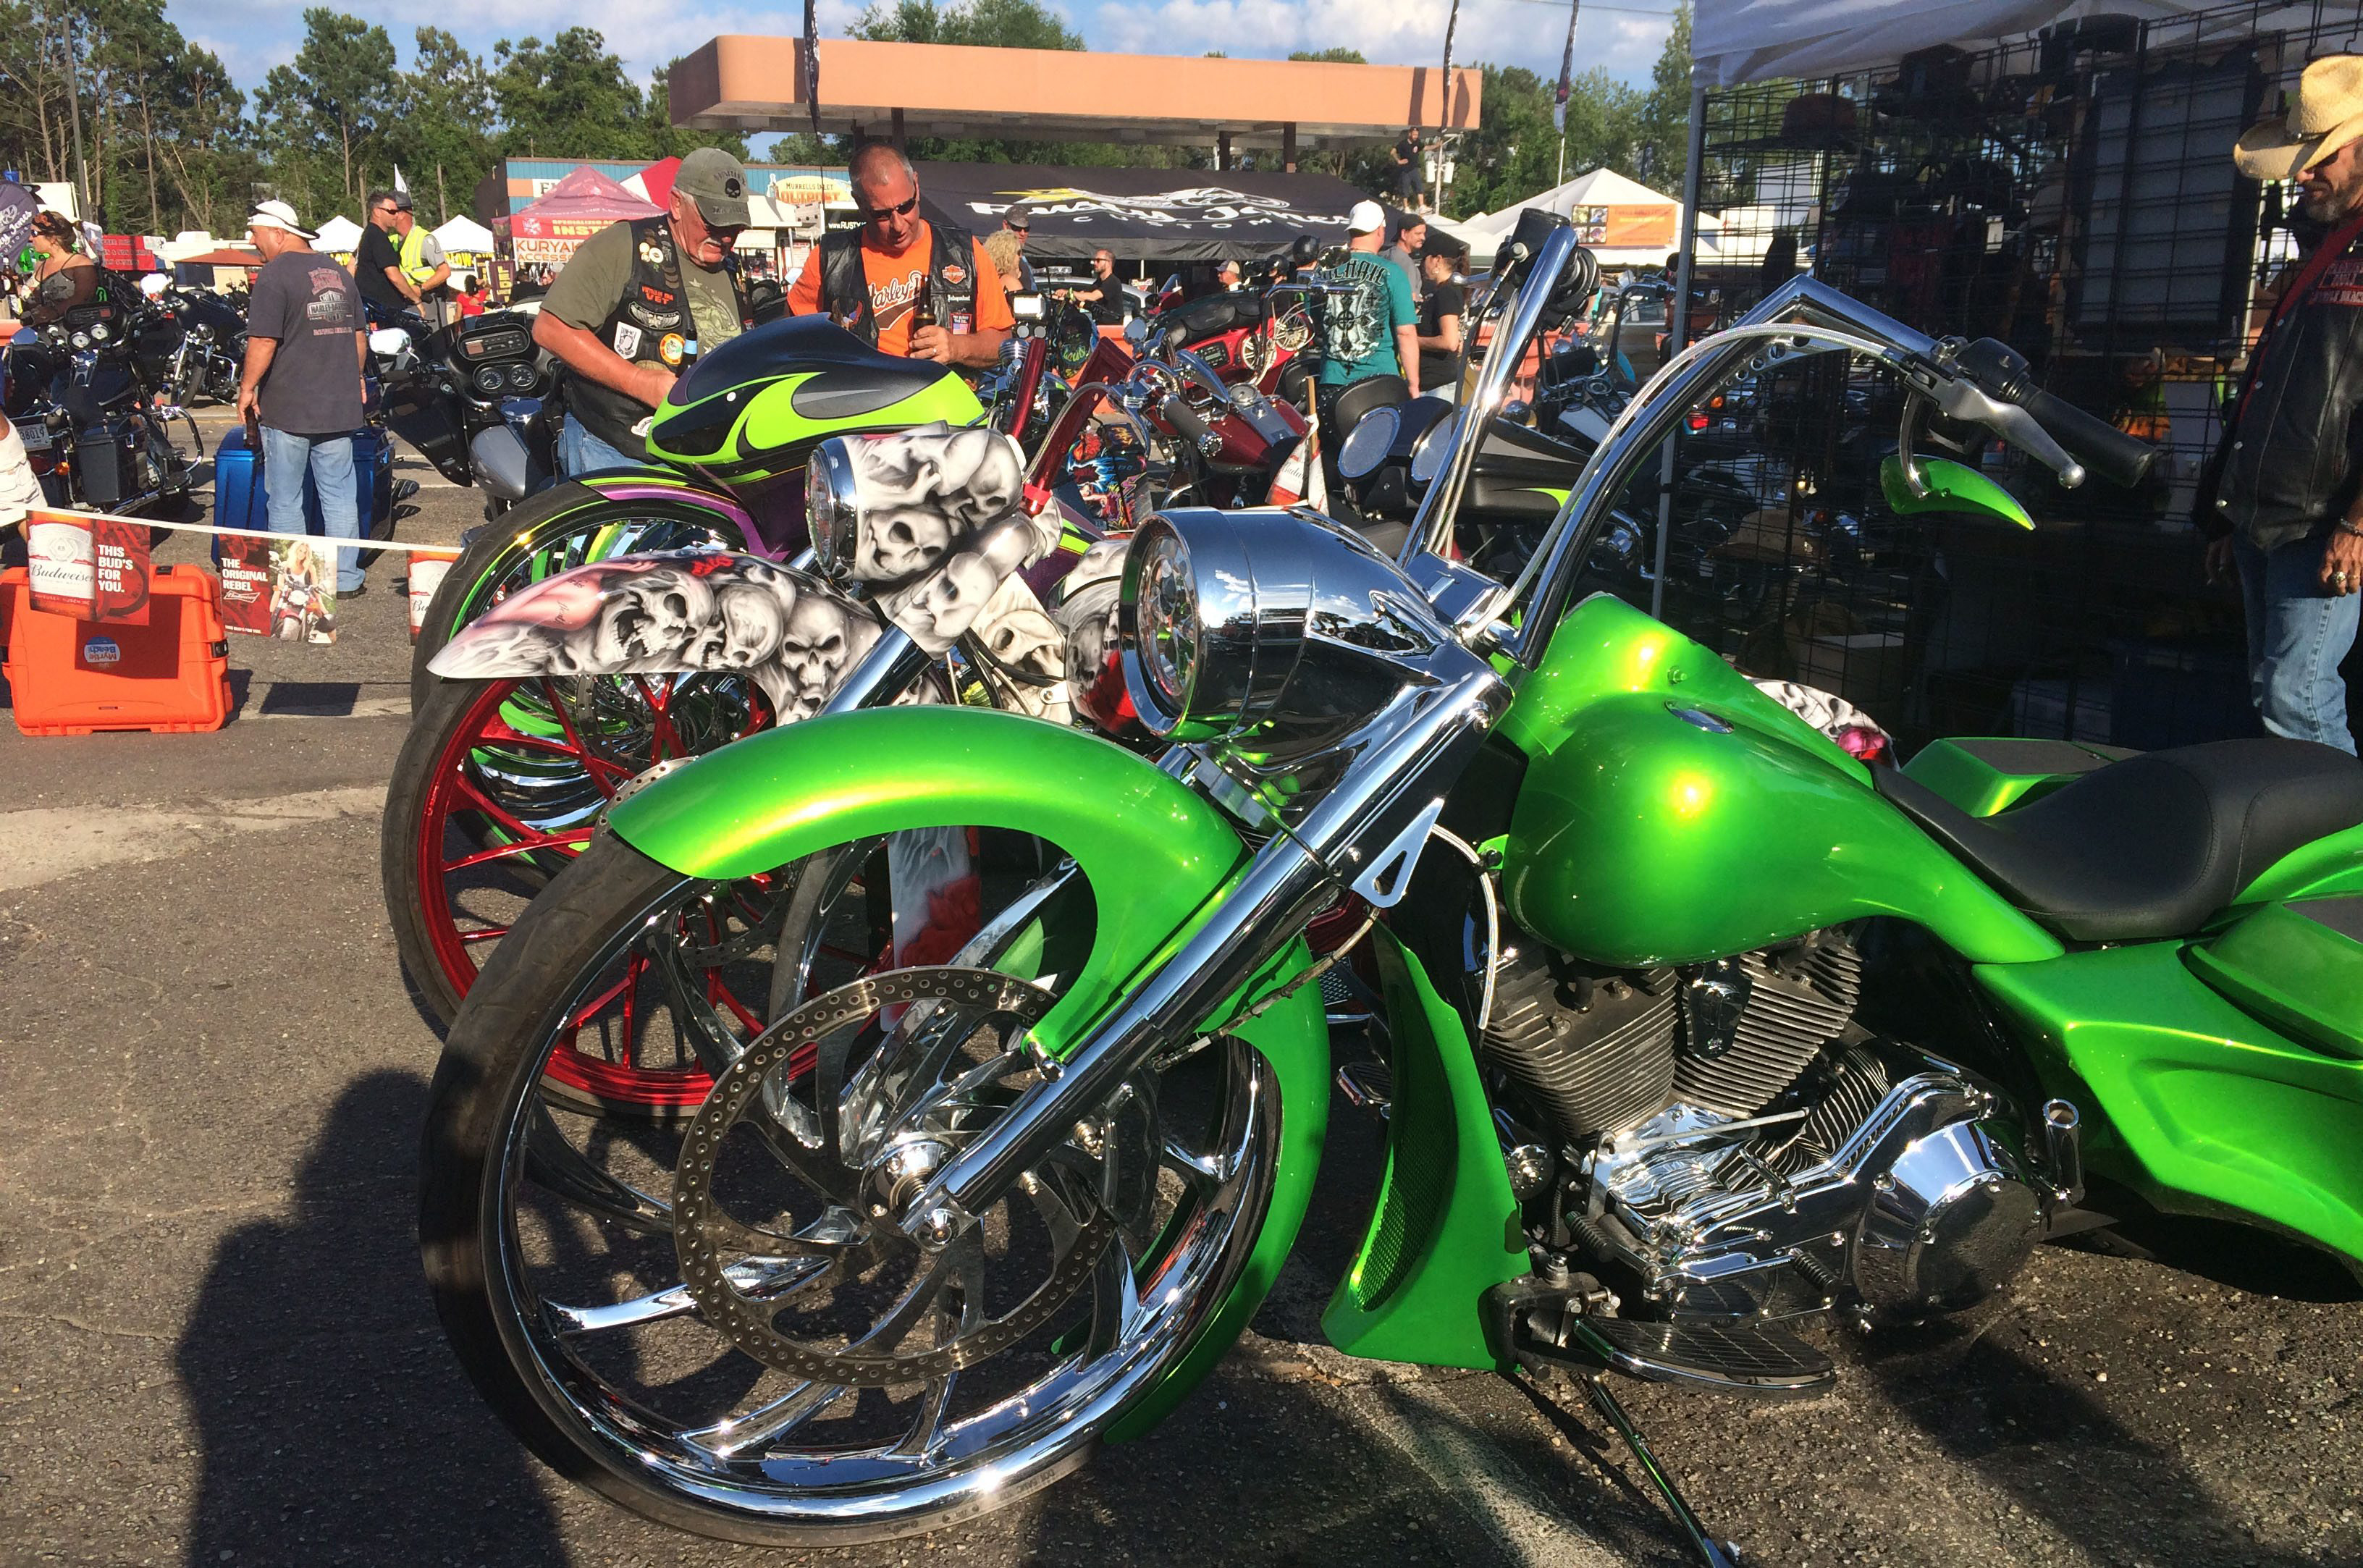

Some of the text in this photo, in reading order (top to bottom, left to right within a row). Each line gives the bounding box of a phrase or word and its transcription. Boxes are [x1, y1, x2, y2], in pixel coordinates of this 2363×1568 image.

[552, 225, 609, 236] INST
[98, 544, 125, 557] THIS
[98, 556, 133, 570] BUD'S
[222, 557, 240, 569] THE
[30, 563, 94, 583] Budweiser
[98, 568, 121, 581] FOR
[222, 568, 268, 581] ORIGINAL
[98, 580, 125, 593] YOU.
[222, 580, 253, 591] REBEL
